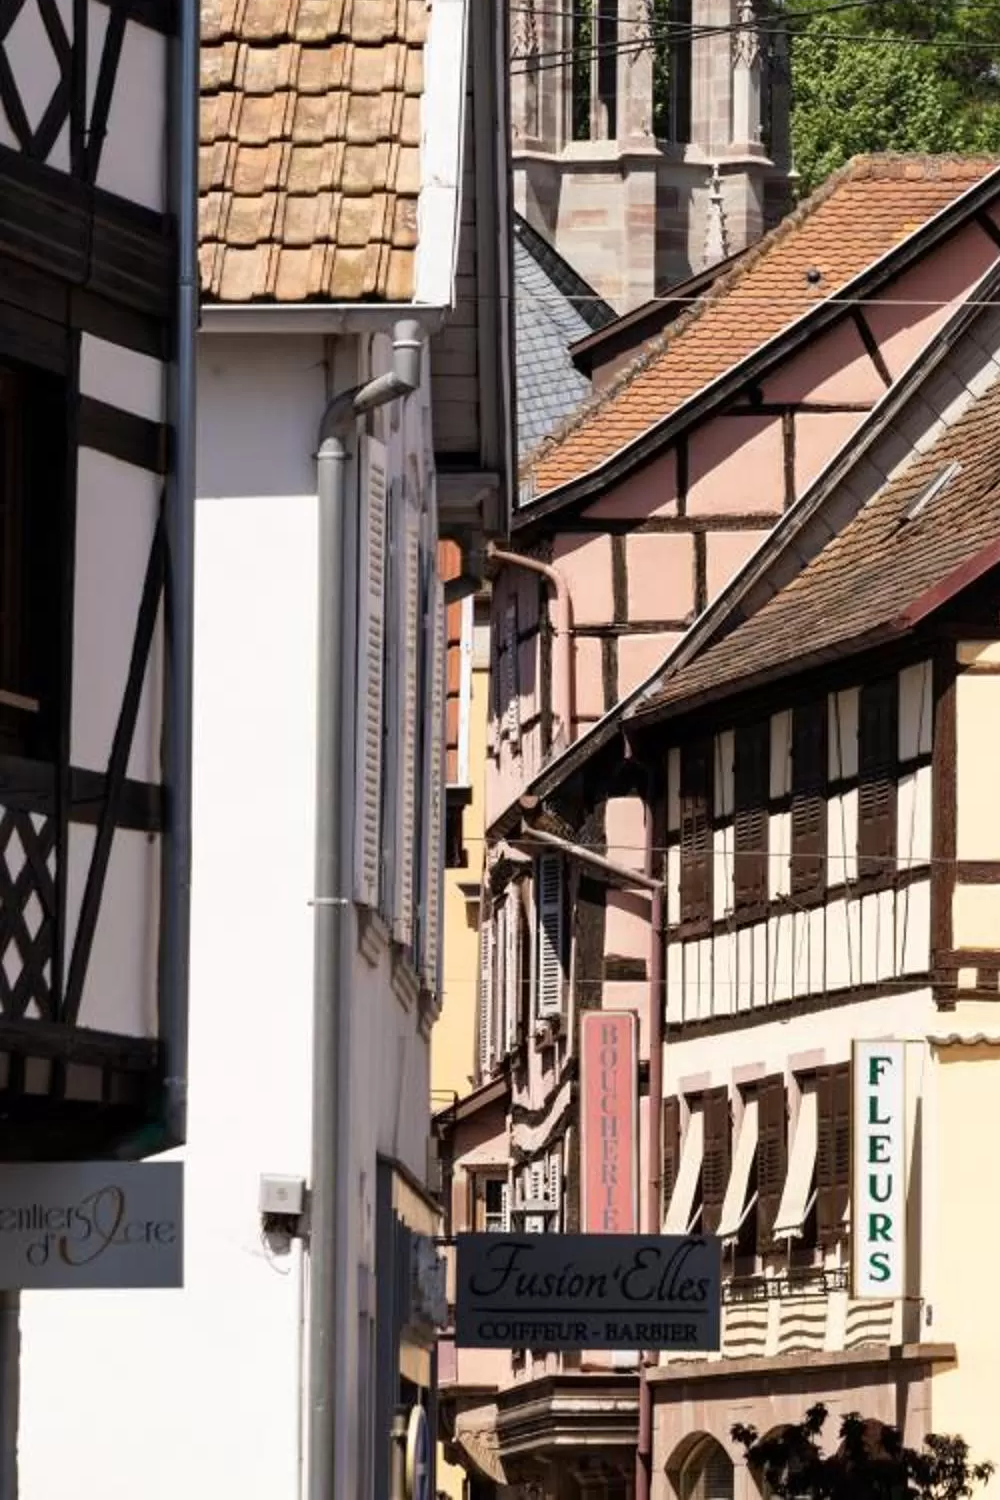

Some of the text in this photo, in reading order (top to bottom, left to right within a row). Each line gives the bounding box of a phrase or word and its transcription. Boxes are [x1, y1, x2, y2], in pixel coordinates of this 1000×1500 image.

[600, 1022, 619, 1232] BOUCHERIE
[867, 1056, 894, 1283] FLEURS
[477, 1322, 589, 1343] COIFFEUR
[604, 1322, 699, 1343] BARBIER
